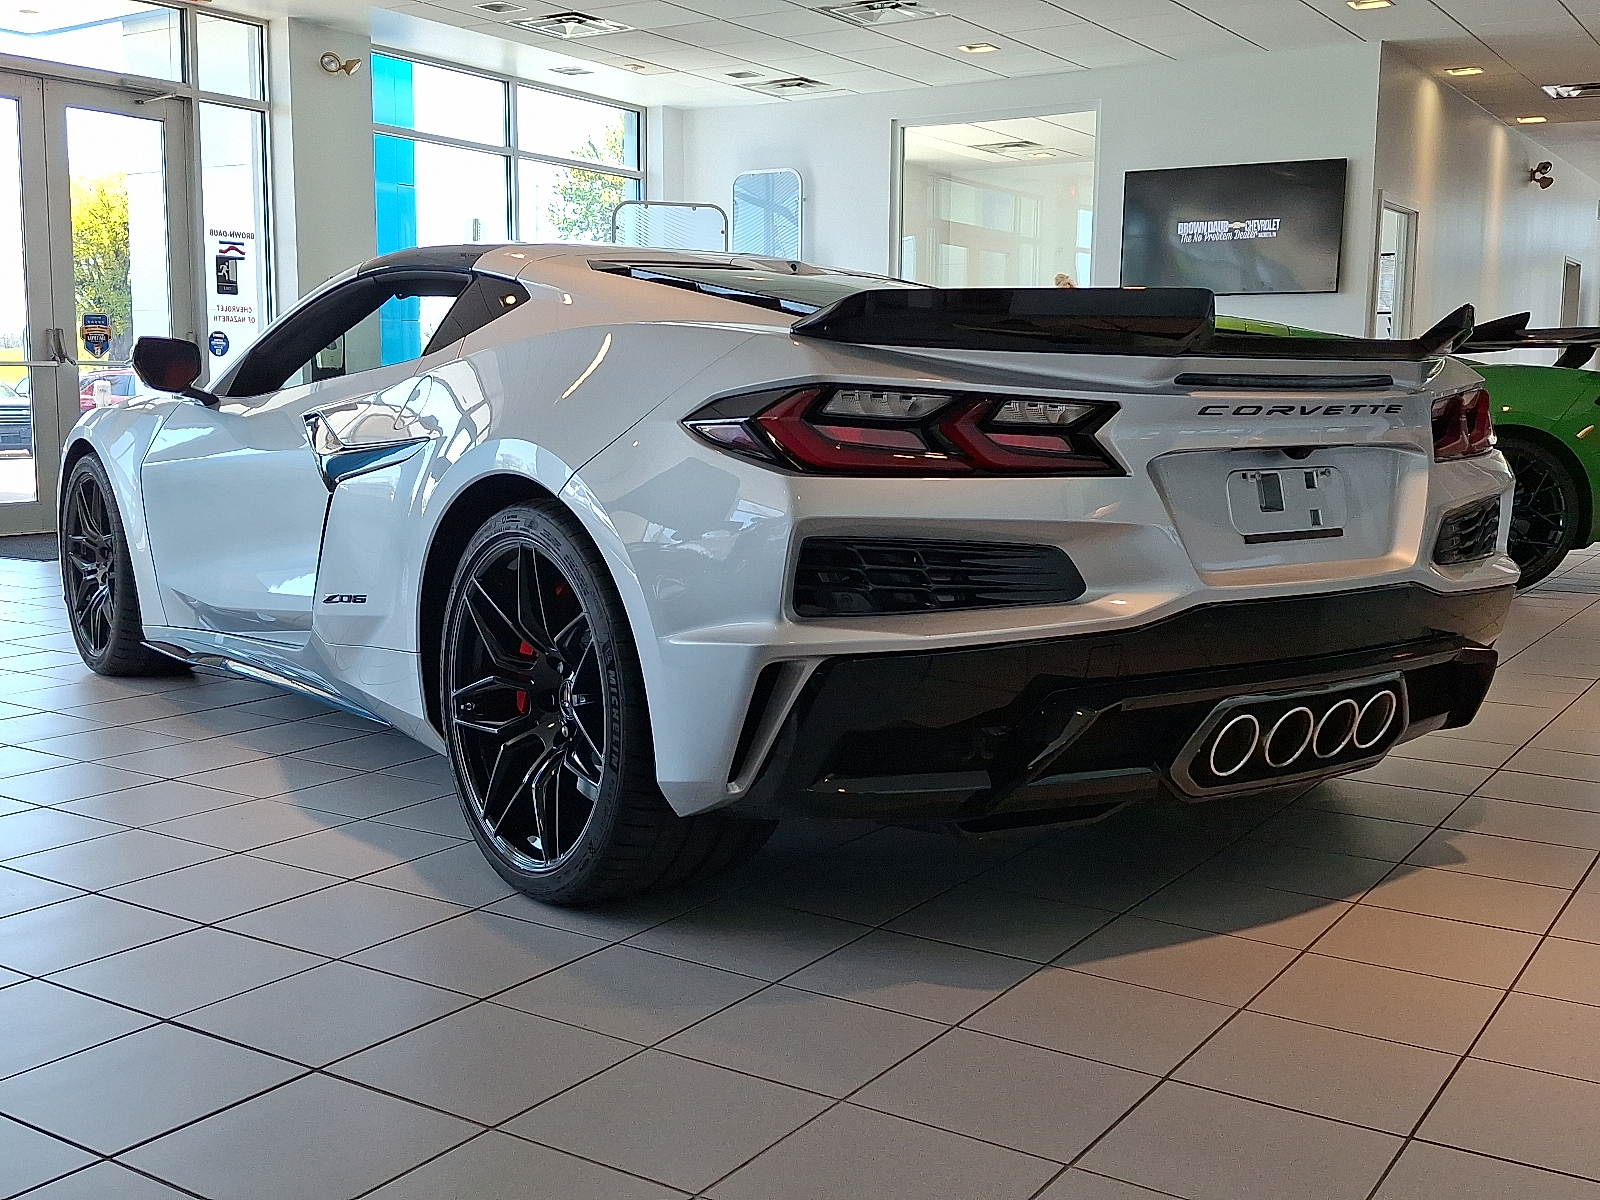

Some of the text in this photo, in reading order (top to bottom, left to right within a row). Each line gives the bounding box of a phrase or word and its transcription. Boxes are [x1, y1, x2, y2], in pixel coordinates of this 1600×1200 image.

[1177, 219, 1281, 234] BROWN DAUB CHEVROLET
[1180, 233, 1192, 243] The
[1193, 233, 1203, 243] No
[1204, 232, 1233, 242] Problem
[1234, 229, 1258, 240] Dealer
[1197, 404, 1404, 416] CORVETTE
[322, 592, 368, 604] Z06
[608, 668, 620, 768] MICHELIN
